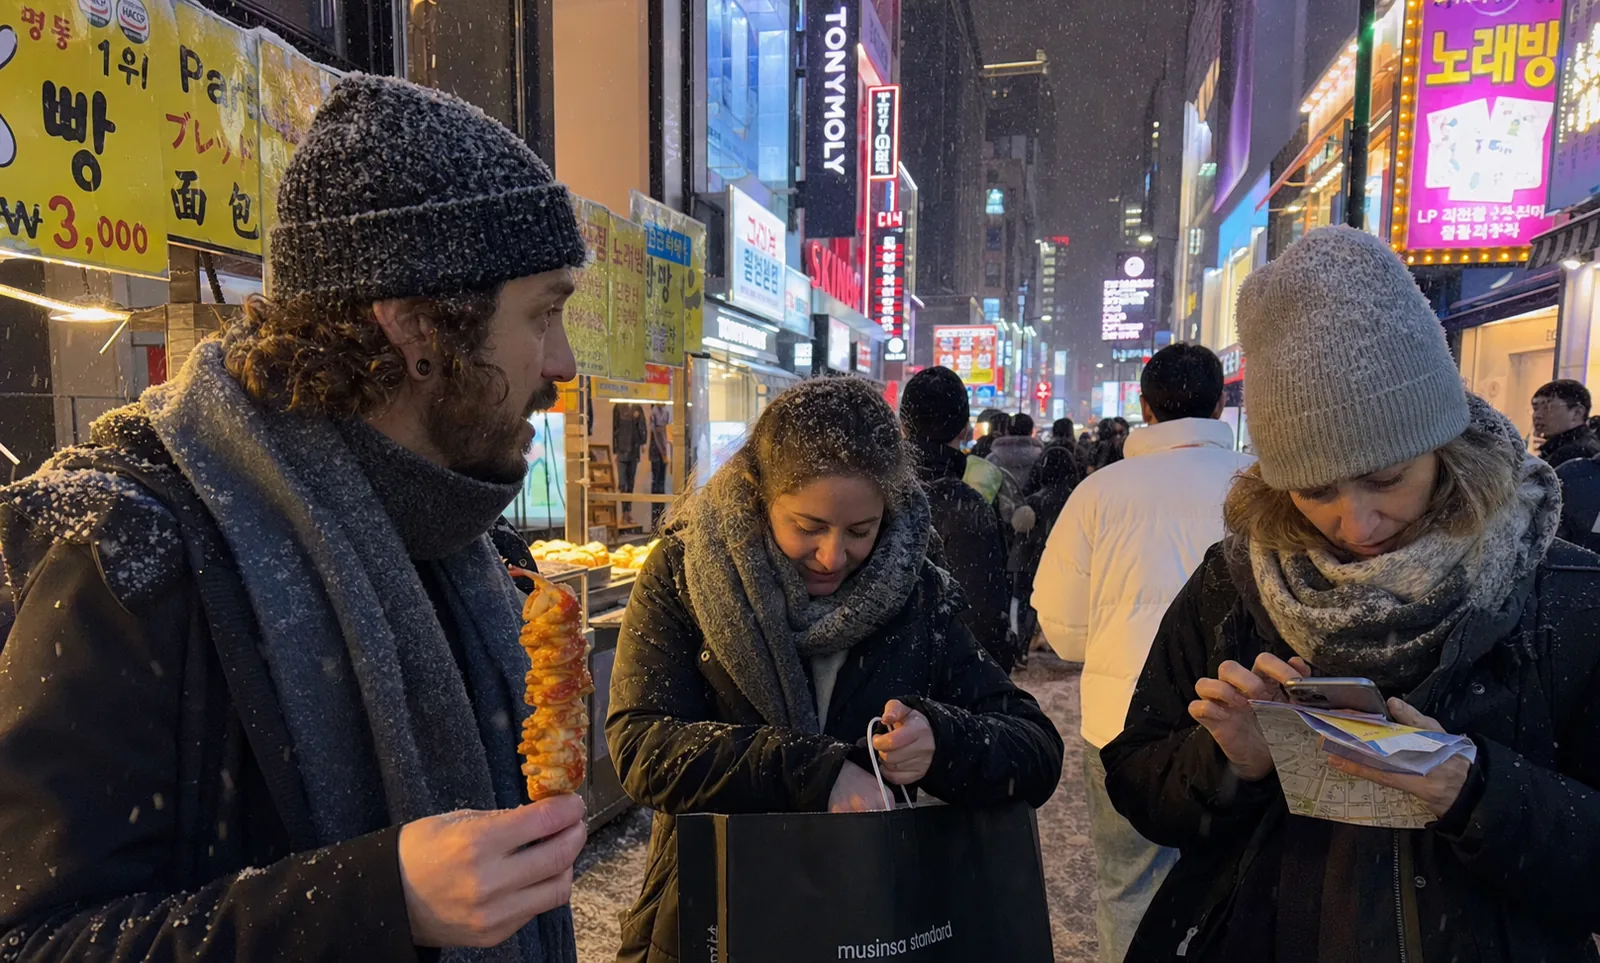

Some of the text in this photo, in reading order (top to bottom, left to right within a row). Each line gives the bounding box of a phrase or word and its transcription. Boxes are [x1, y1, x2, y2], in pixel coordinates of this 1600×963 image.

[97, 39, 149, 90] 1위
[823, 6, 847, 175] TONYMOLY
[42, 80, 116, 192] 빵
[171, 170, 259, 240] 面包
[1417, 209, 1438, 224] LP
[837, 920, 953, 959] musinsa standard
